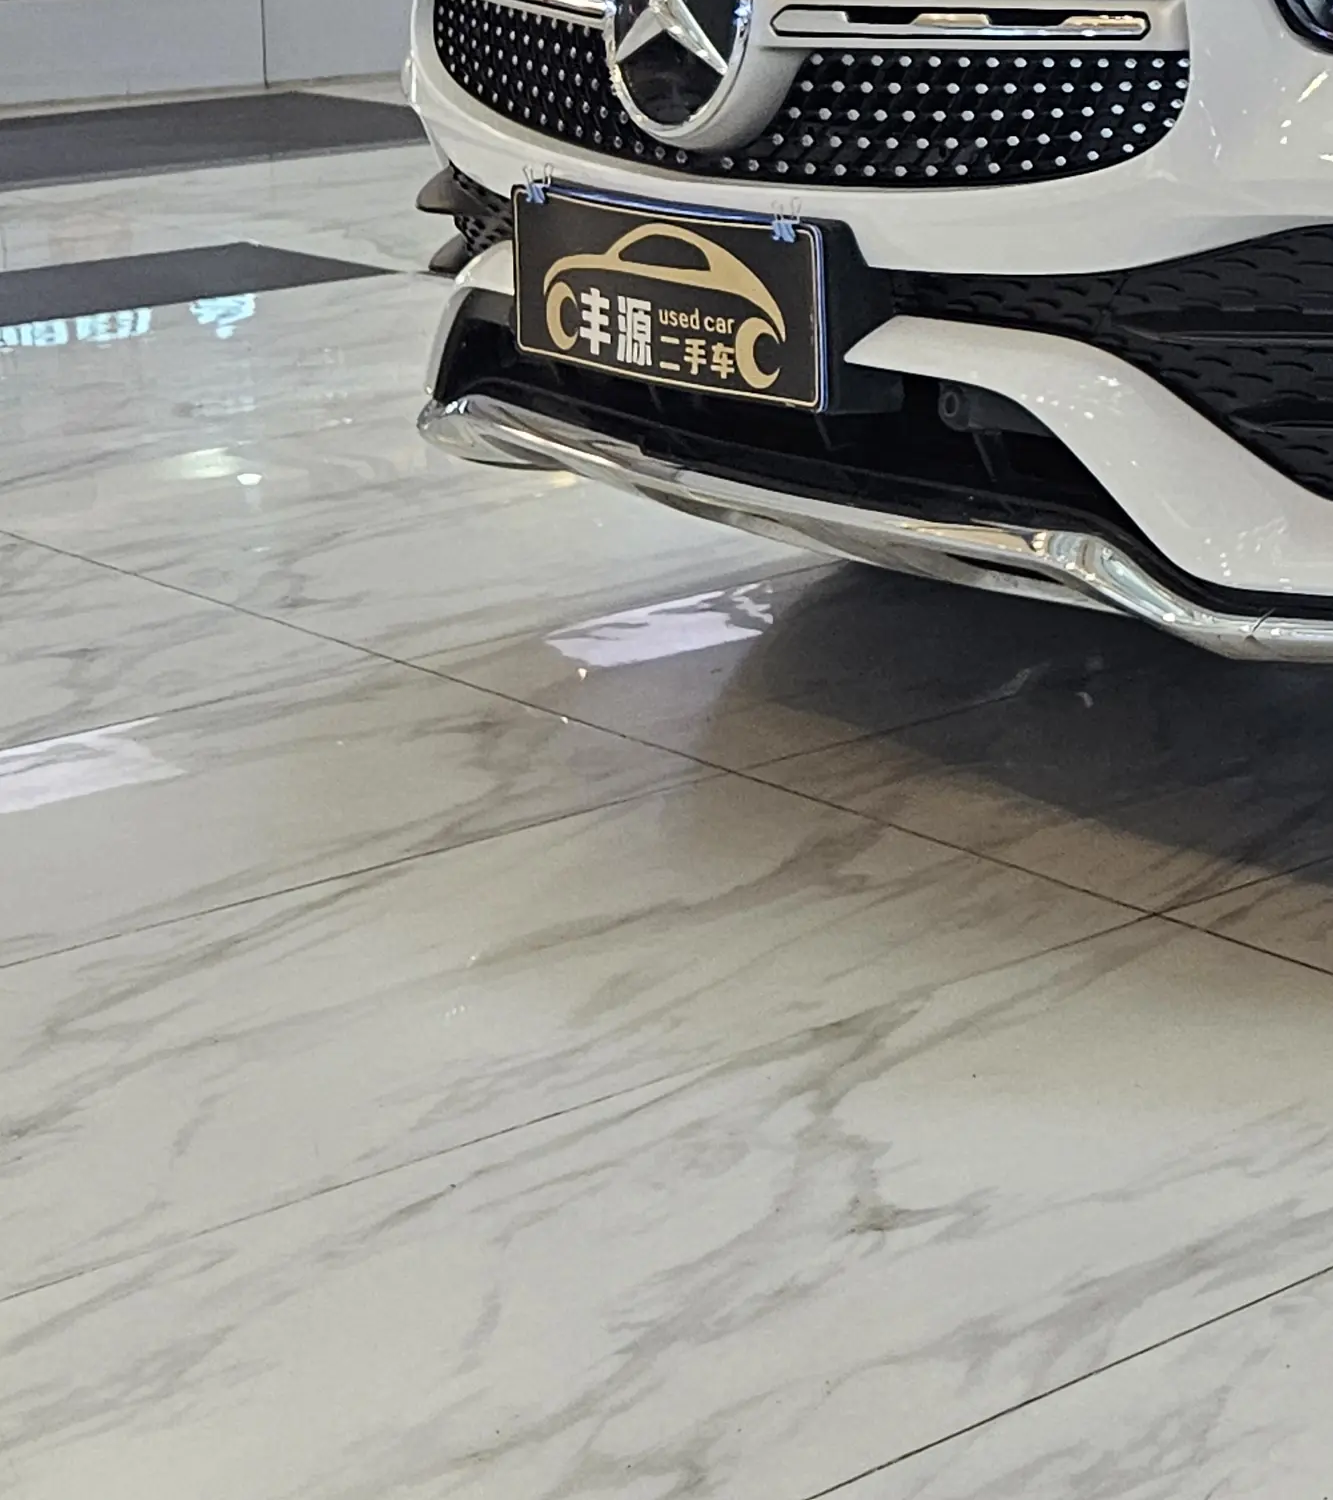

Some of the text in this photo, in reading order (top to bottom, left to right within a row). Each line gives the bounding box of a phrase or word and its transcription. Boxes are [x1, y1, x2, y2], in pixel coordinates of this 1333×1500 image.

[579, 287, 653, 367] 丰源
[658, 307, 735, 334] used car
[659, 335, 736, 379] 二手车
